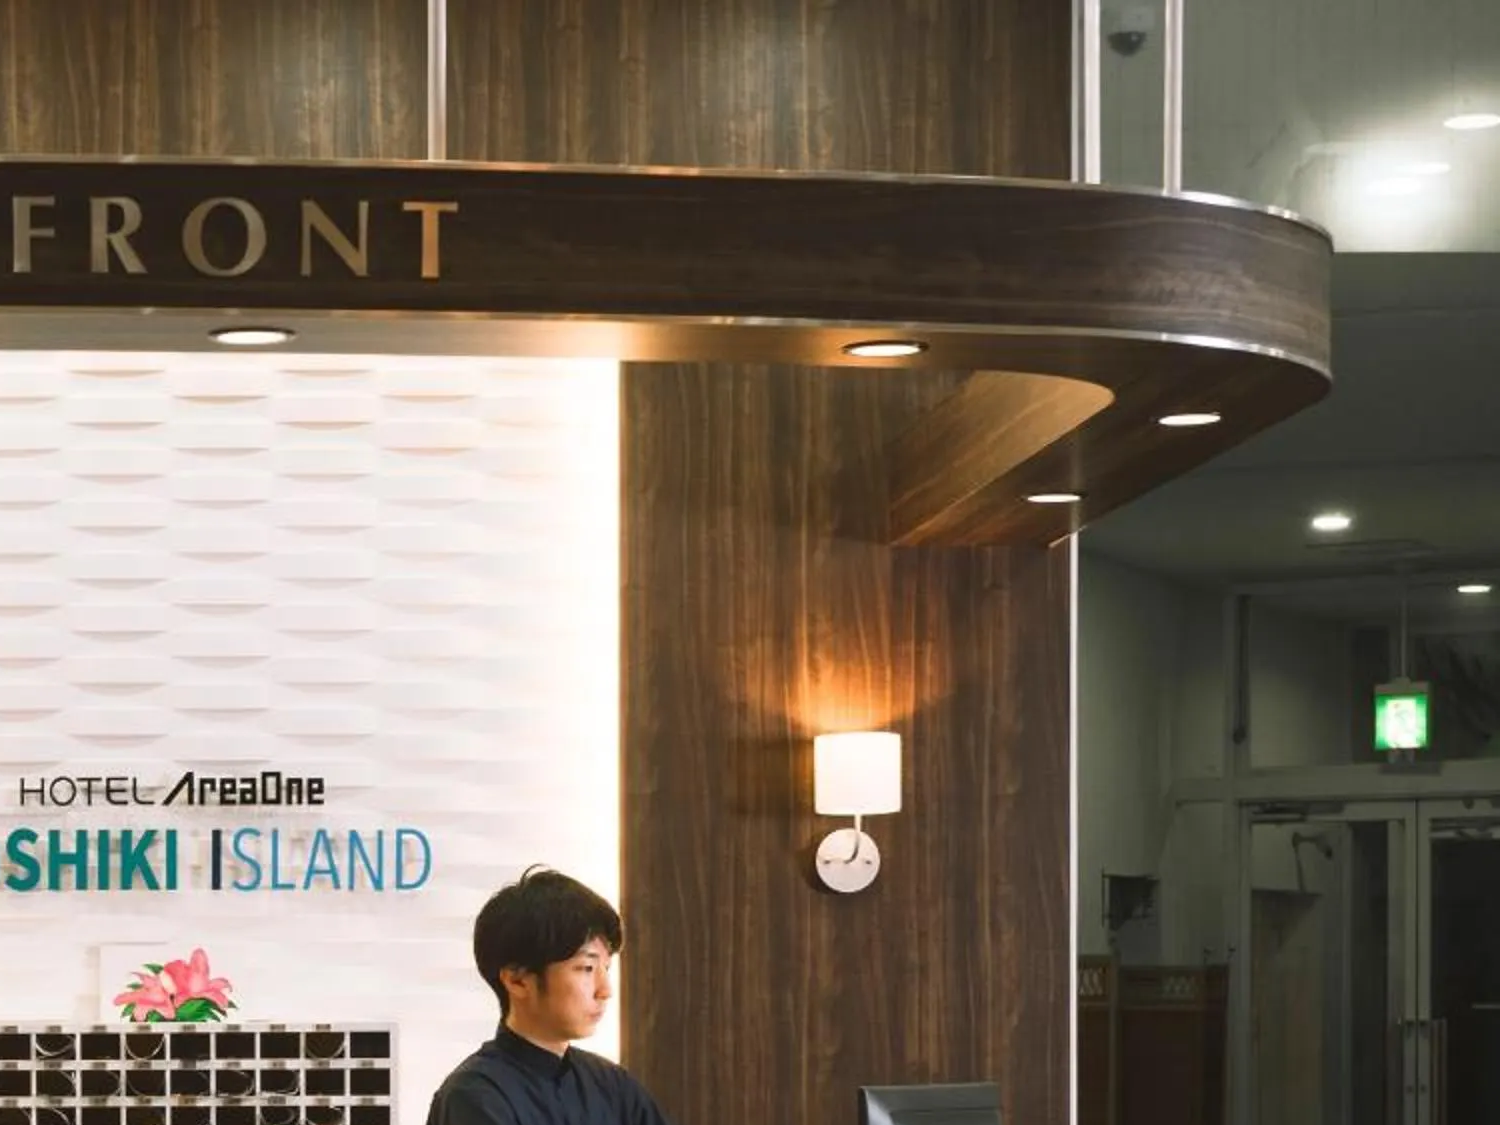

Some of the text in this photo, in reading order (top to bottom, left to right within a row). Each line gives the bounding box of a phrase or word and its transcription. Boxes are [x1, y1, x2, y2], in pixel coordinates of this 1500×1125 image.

[12, 195, 459, 278] FRONT
[19, 771, 326, 807] HOTEL AreaOne
[210, 828, 432, 892] ISLAND
